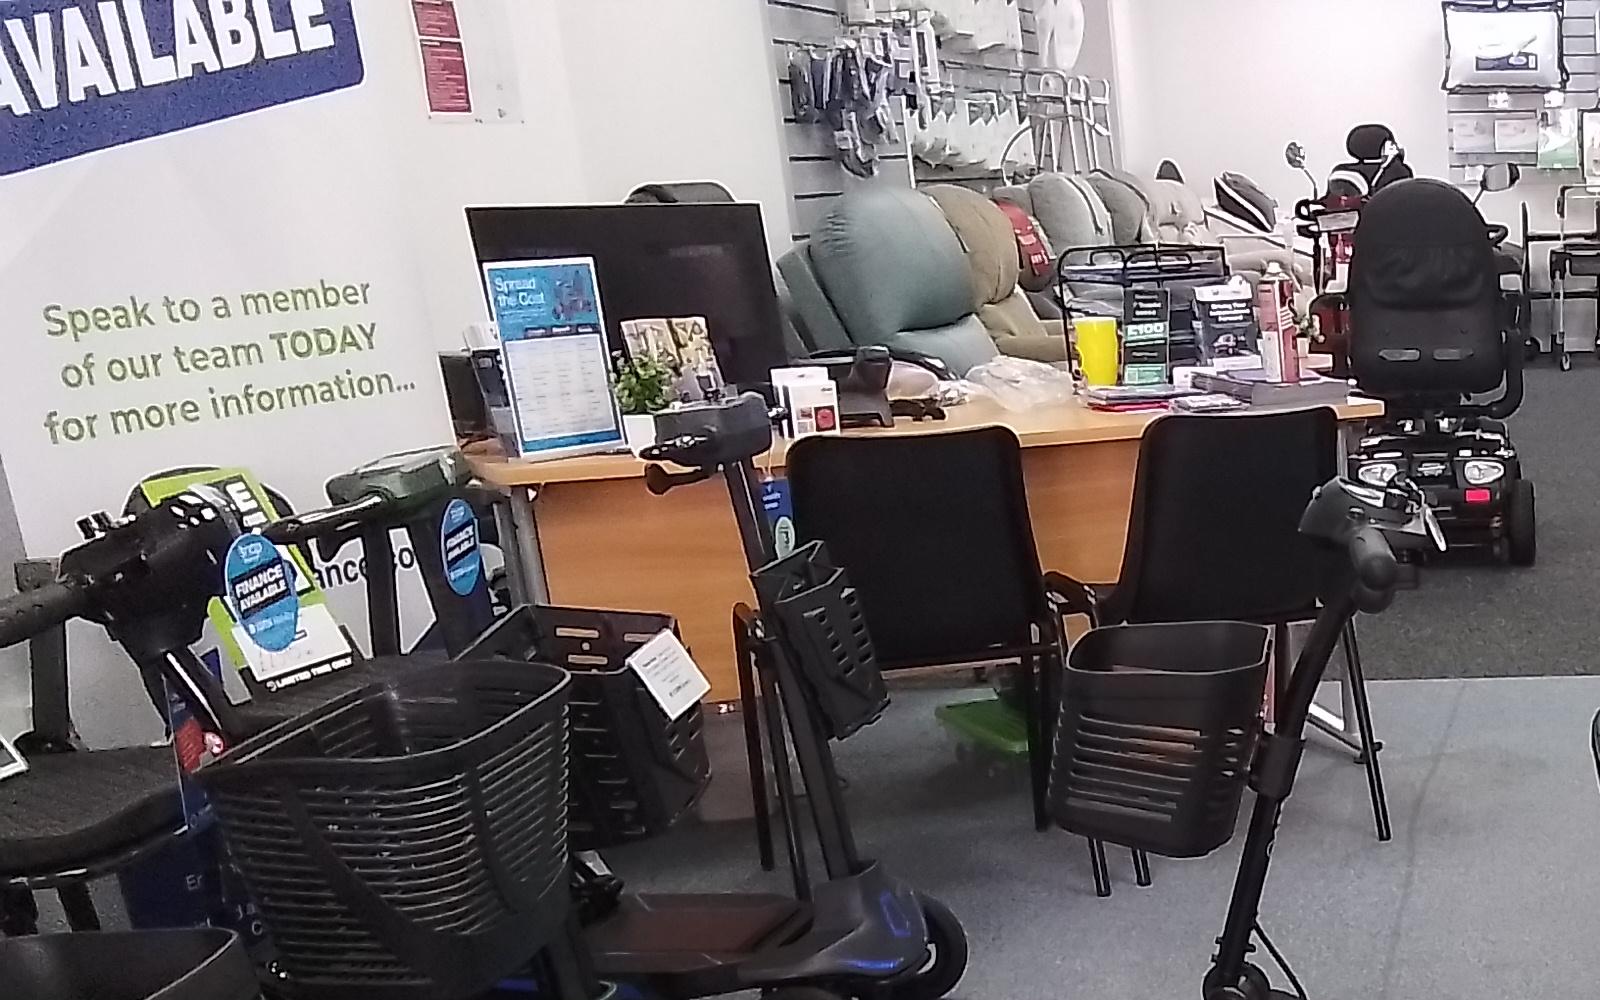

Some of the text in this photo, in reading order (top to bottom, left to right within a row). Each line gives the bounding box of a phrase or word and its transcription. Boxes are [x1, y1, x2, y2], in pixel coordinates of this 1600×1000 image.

[495, 277, 536, 295] Spread
[519, 291, 545, 306] Cost
[43, 279, 371, 342] Speak to a member
[60, 322, 376, 389] of our team TODAY
[44, 369, 415, 444] for more information...
[235, 564, 284, 598] FINANCE
[239, 579, 288, 613] AVAILABLE
